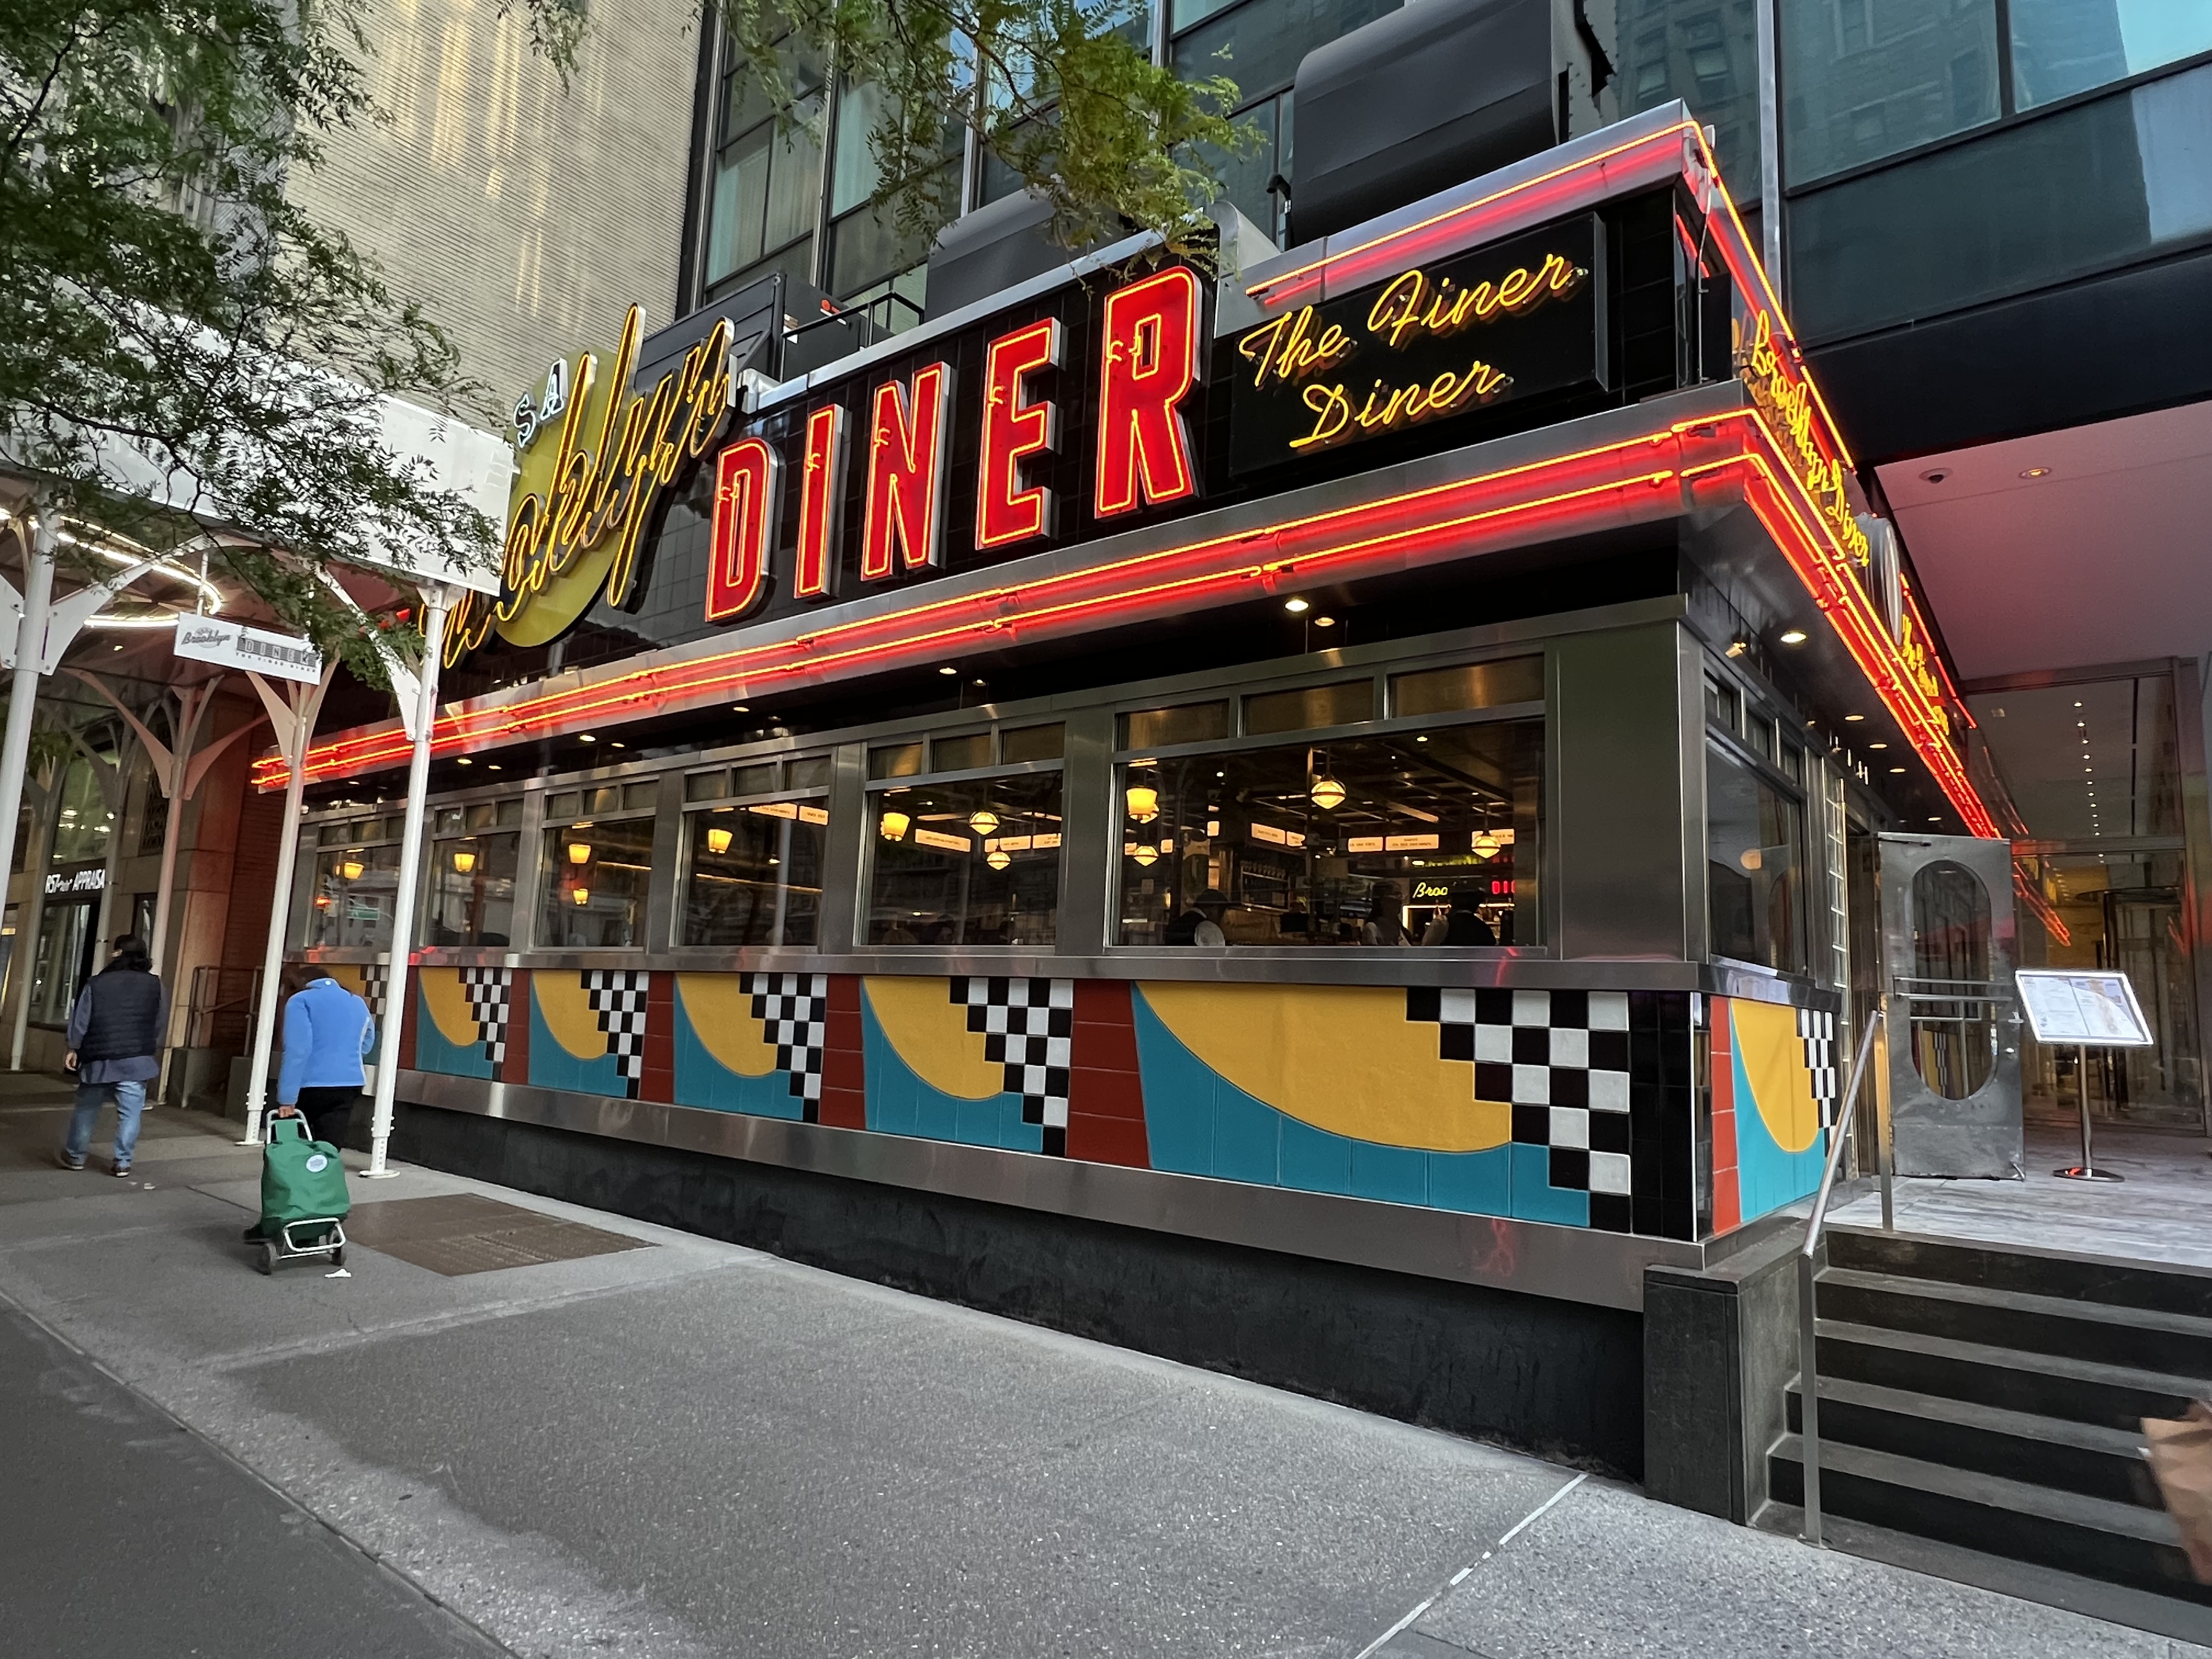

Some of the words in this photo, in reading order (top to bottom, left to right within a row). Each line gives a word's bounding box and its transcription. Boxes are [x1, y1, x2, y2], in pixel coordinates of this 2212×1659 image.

[1238, 304, 1350, 387] The
[1367, 252, 1578, 347] Finer
[706, 266, 1201, 623] DINER
[1289, 359, 1506, 448] Diner
